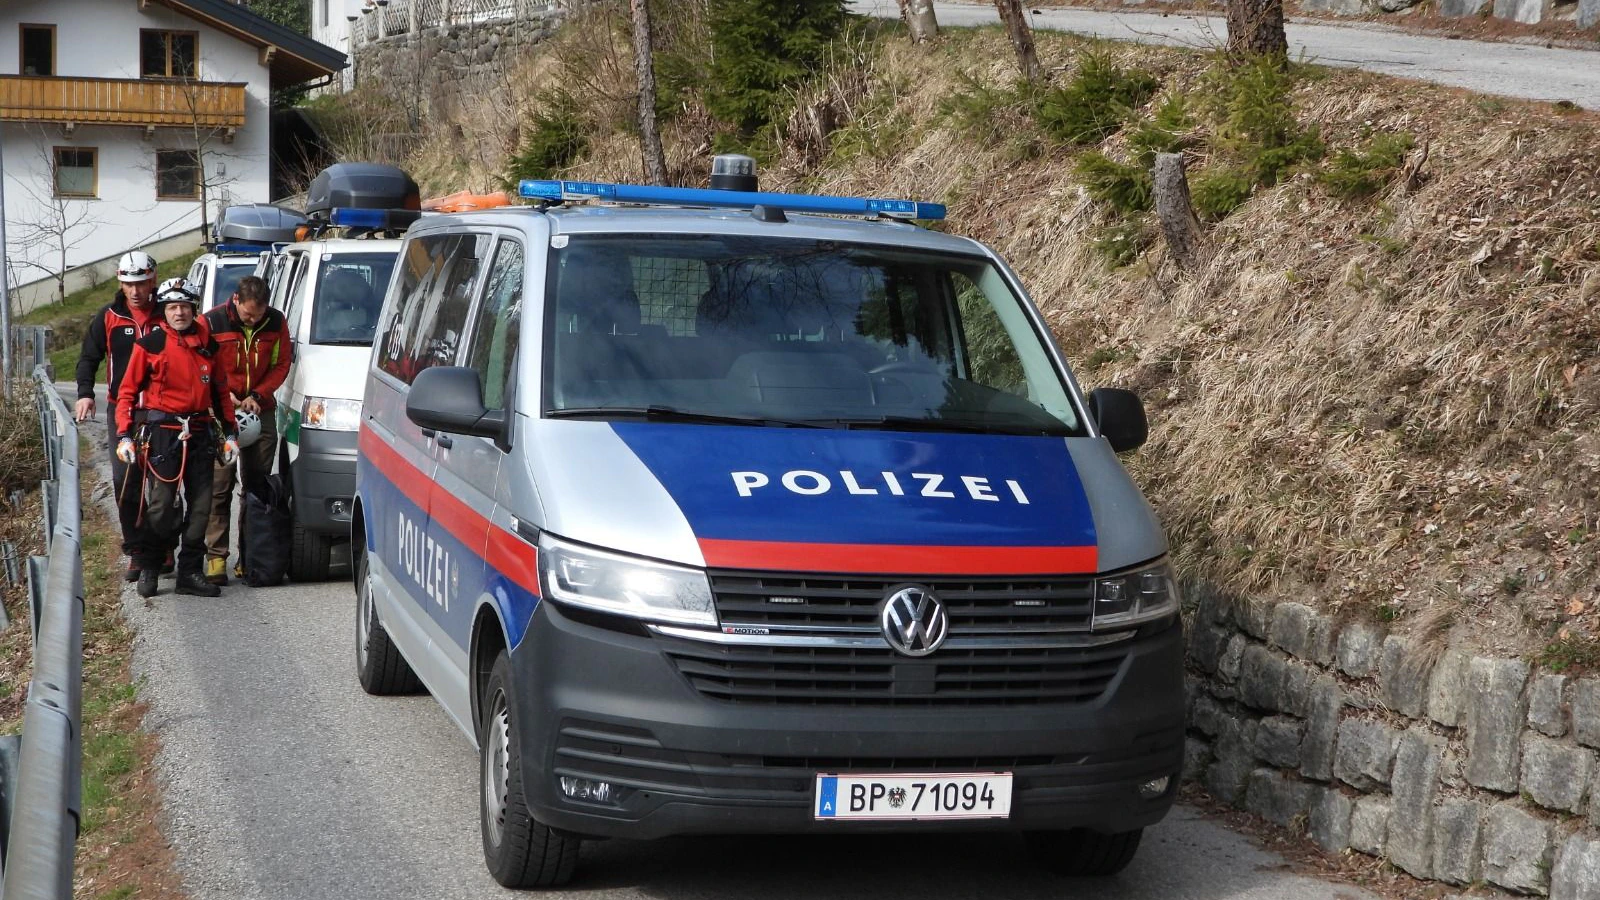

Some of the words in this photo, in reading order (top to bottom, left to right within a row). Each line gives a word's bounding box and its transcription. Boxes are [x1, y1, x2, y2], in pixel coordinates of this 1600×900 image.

[730, 469, 1031, 505] POLIZEI
[398, 511, 450, 613] POLIZEI
[823, 801, 832, 811] A
[850, 783, 886, 812] BP
[911, 781, 995, 812] 71094
